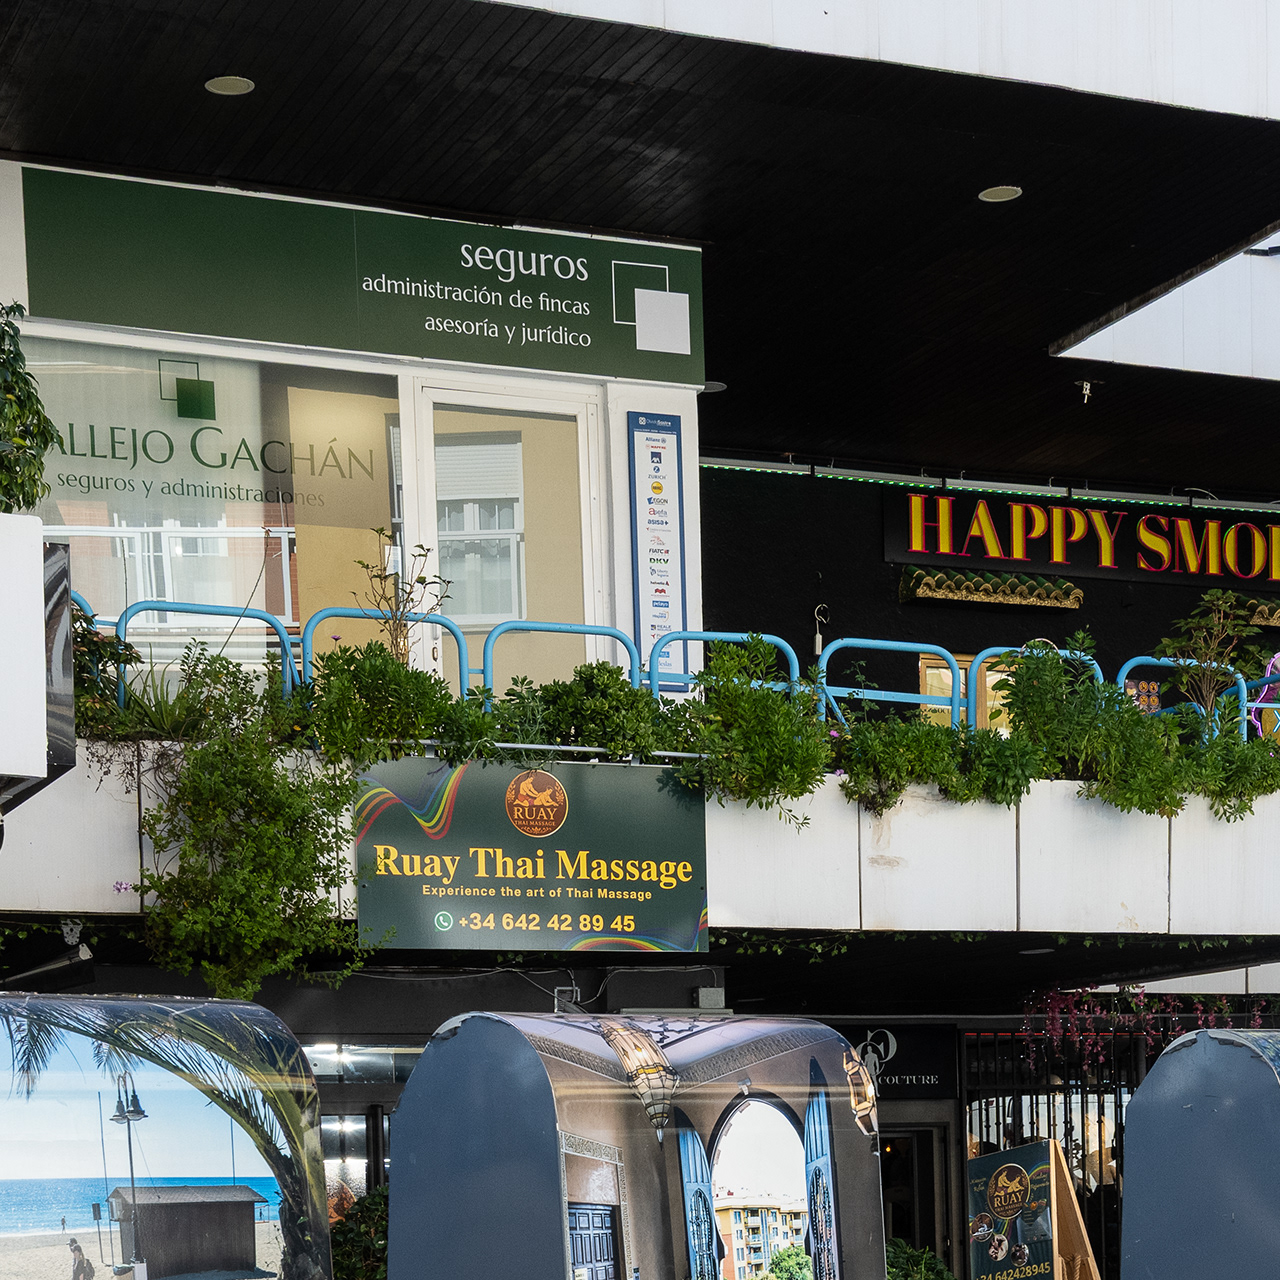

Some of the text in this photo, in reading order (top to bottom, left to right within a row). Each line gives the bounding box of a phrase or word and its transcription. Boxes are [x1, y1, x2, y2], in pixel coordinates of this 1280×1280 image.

[460, 243, 589, 283] seguros
[362, 273, 590, 316] administración de fincas
[424, 316, 591, 347] asesoría y jurídico
[56, 471, 326, 508] seguros y administraciones
[907, 493, 1128, 568] HAPPY
[513, 806, 558, 821] RUAY
[373, 844, 693, 890] Ruay Thai Massage
[422, 884, 652, 901] Experience the art of Thai Massage
[458, 912, 635, 932] +34 642 42 89 45
[878, 1075, 939, 1085] COUTURE
[994, 1191, 1024, 1208] RUAY
